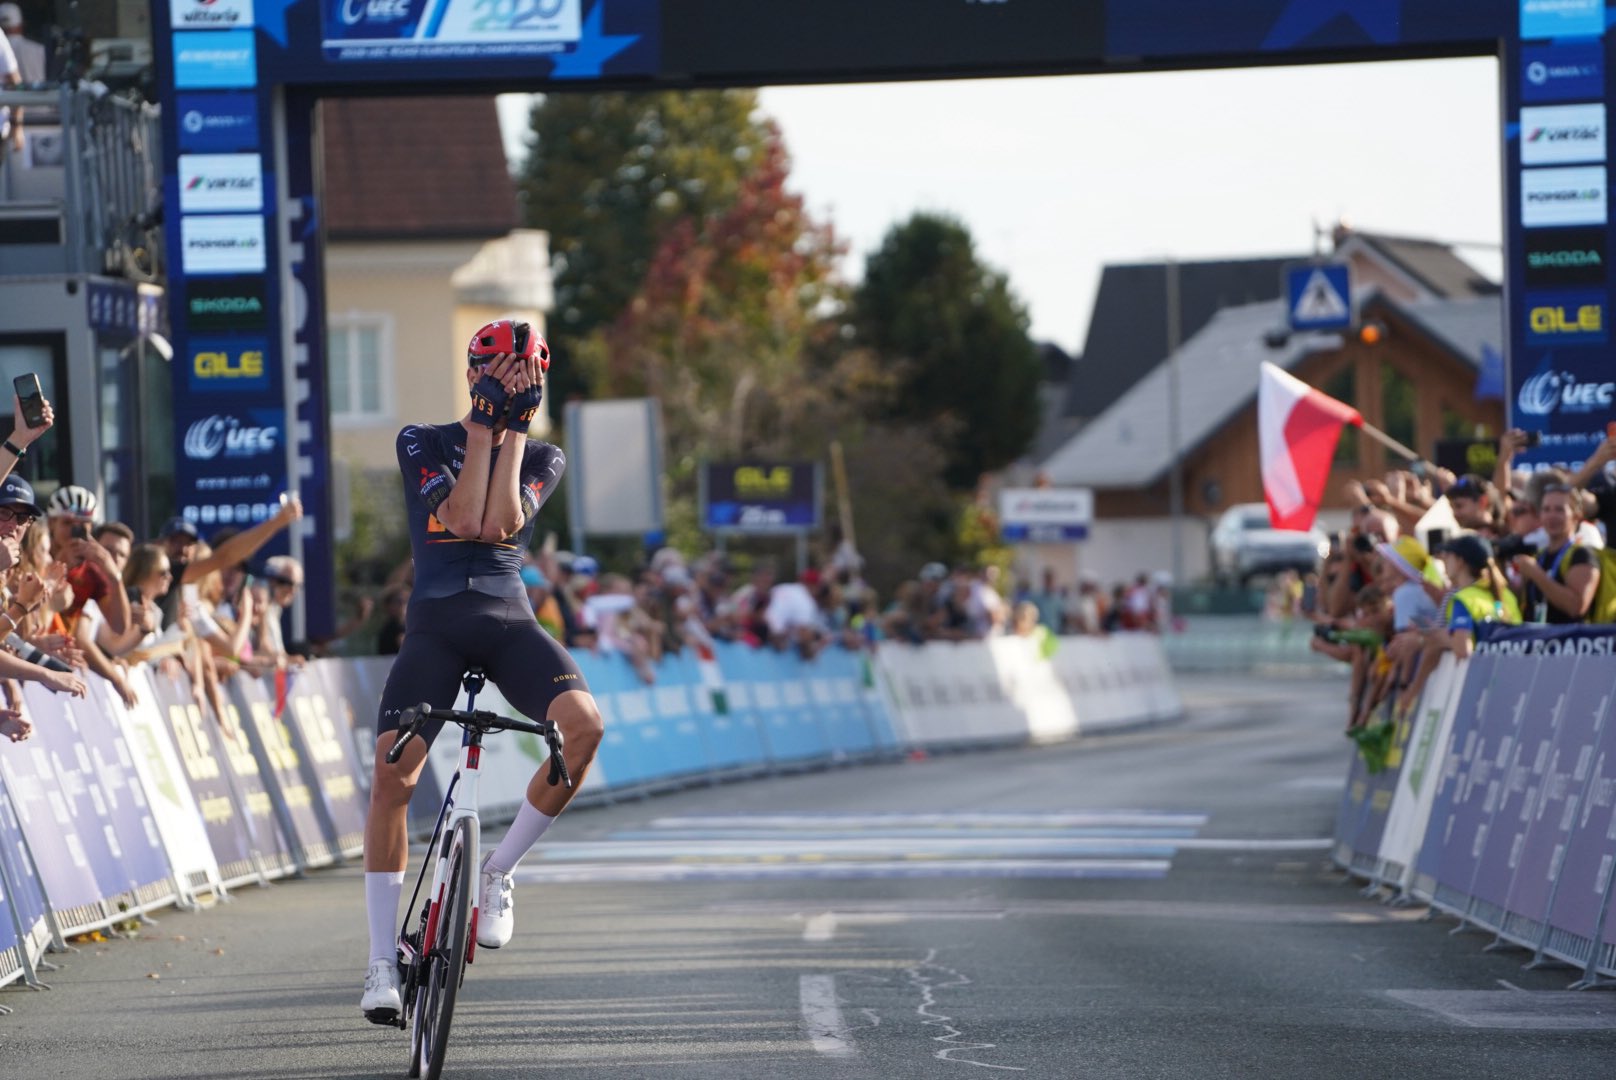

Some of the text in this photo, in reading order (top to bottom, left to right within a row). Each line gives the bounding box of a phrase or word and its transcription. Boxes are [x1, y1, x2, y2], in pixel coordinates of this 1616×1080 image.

[1561, 383, 1616, 405] UEC
[520, 408, 538, 421] SP
[226, 427, 278, 450] UEC
